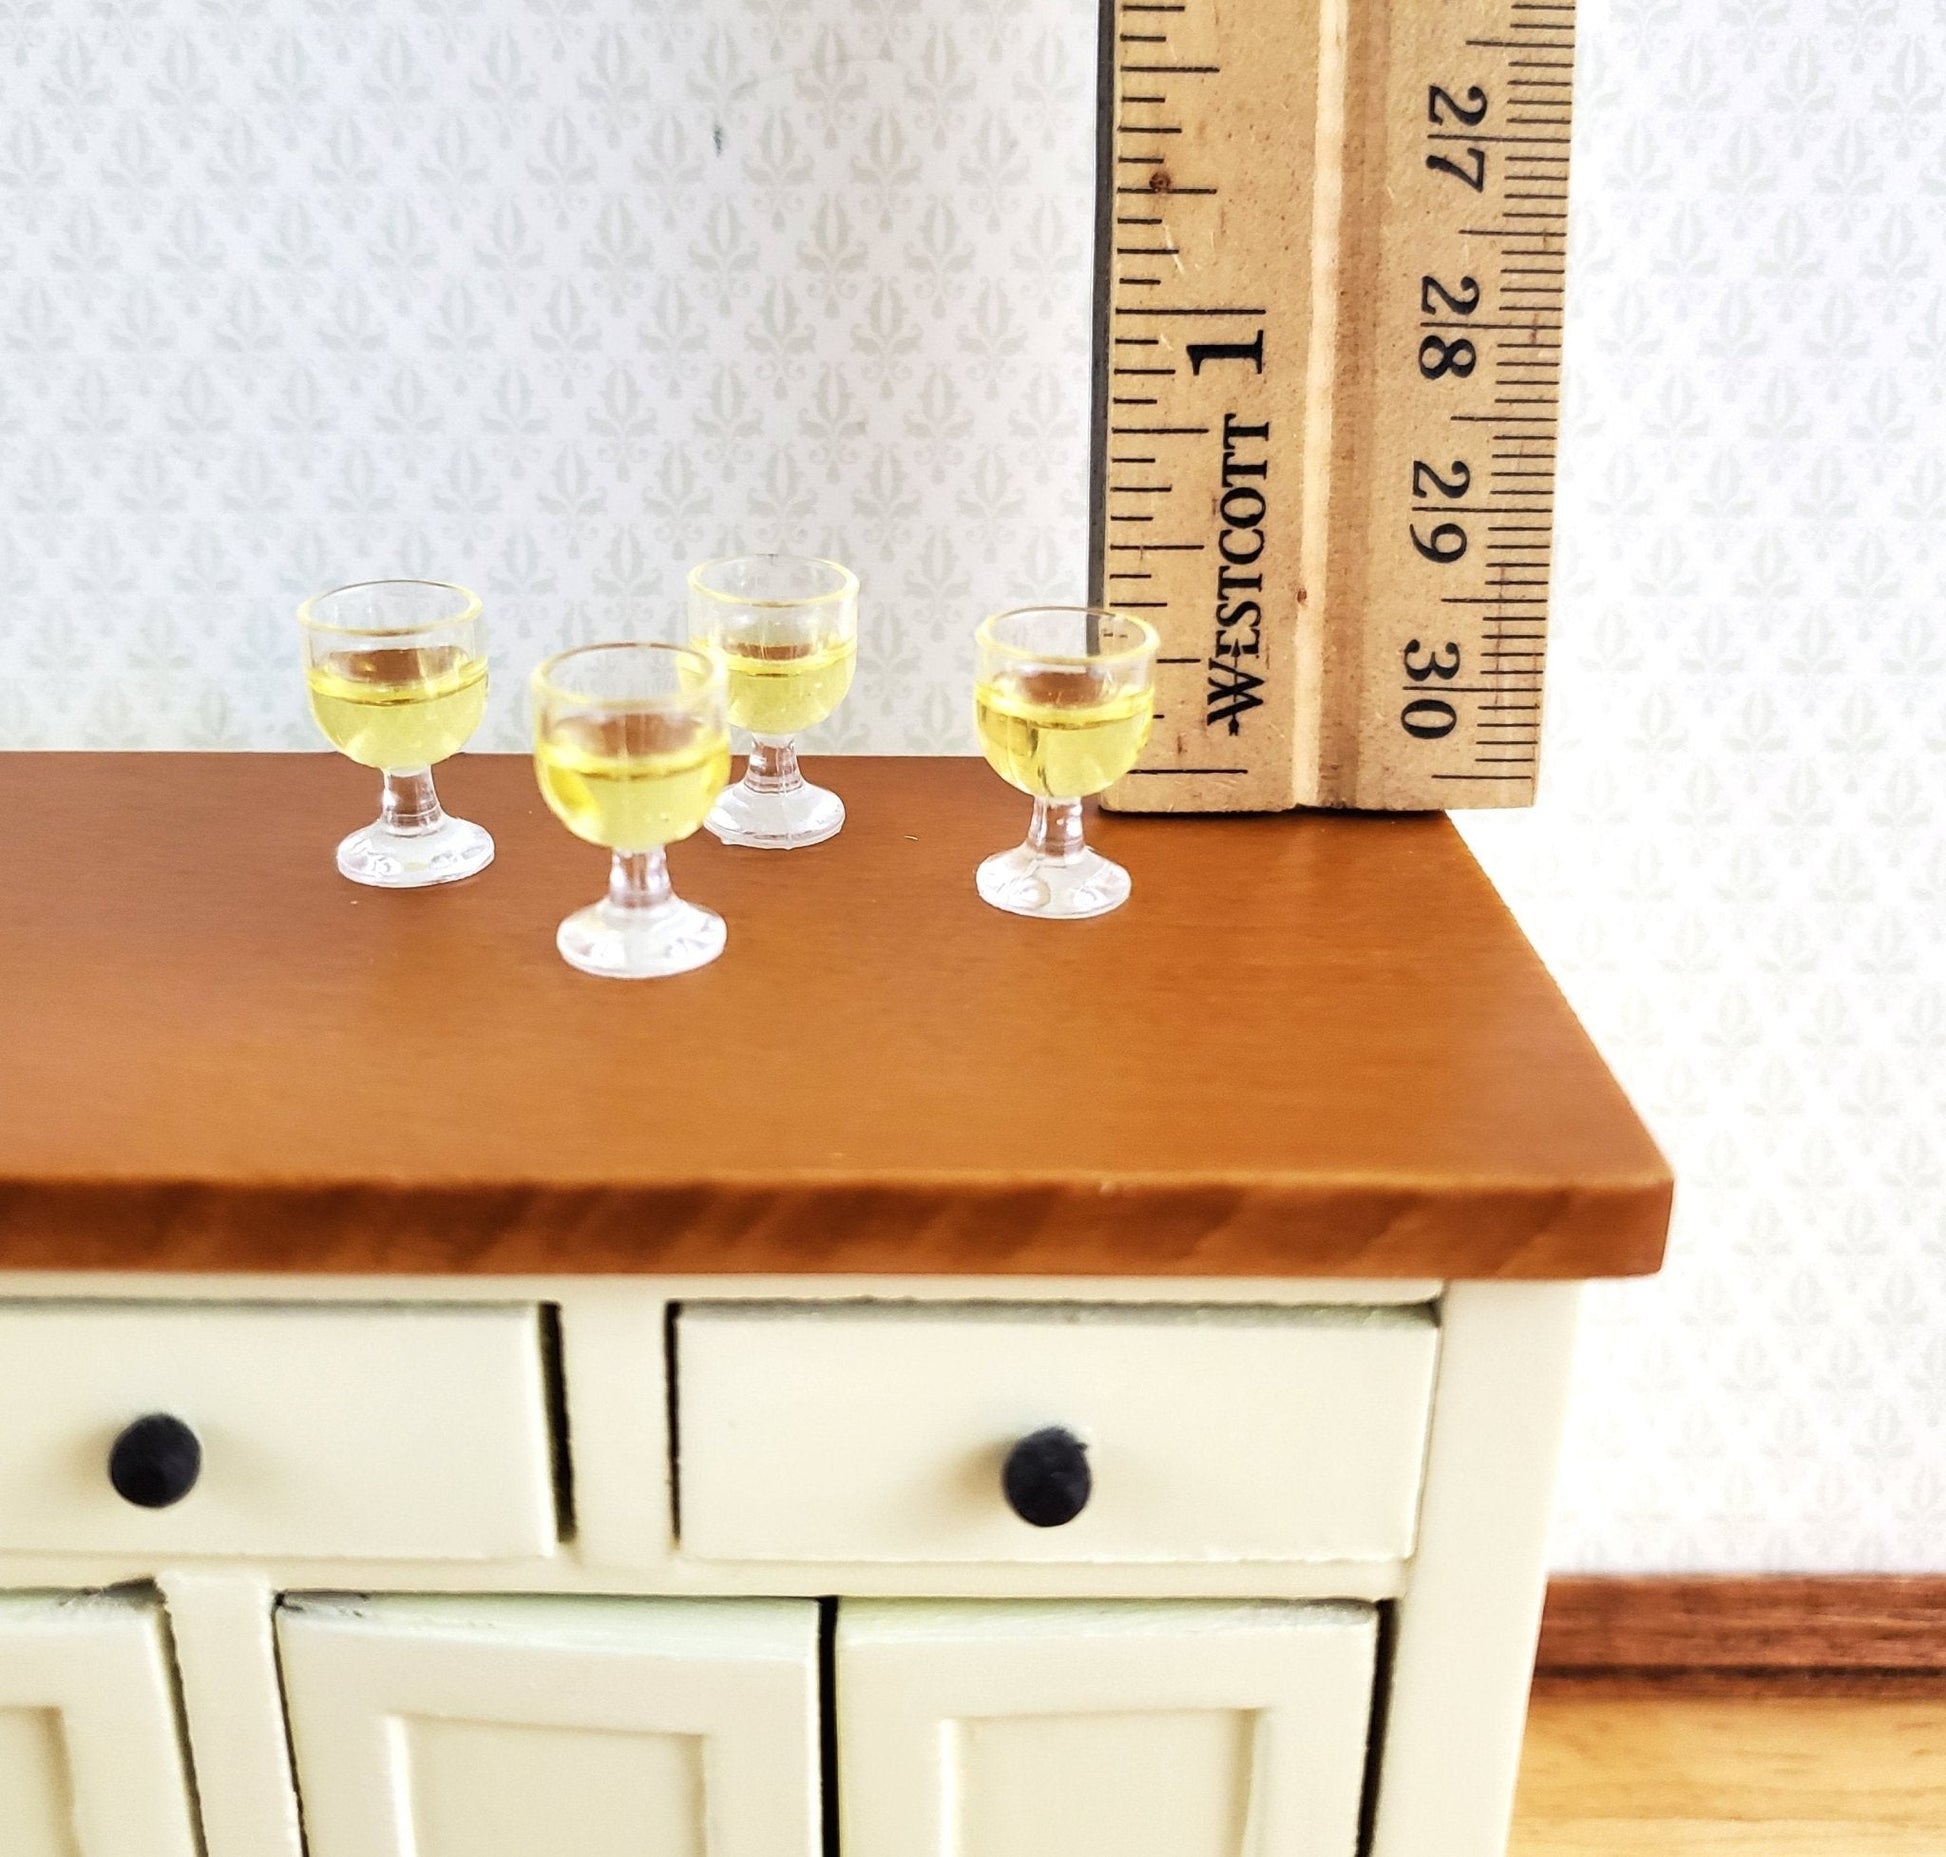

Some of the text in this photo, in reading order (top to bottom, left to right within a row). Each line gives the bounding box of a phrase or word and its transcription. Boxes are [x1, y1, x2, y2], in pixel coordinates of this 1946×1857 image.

[1425, 84, 1488, 194] 27
[1185, 329, 1264, 377] 1
[1417, 275, 1480, 381] 28
[1408, 460, 1471, 564] 29
[1400, 638, 1461, 740] 30
